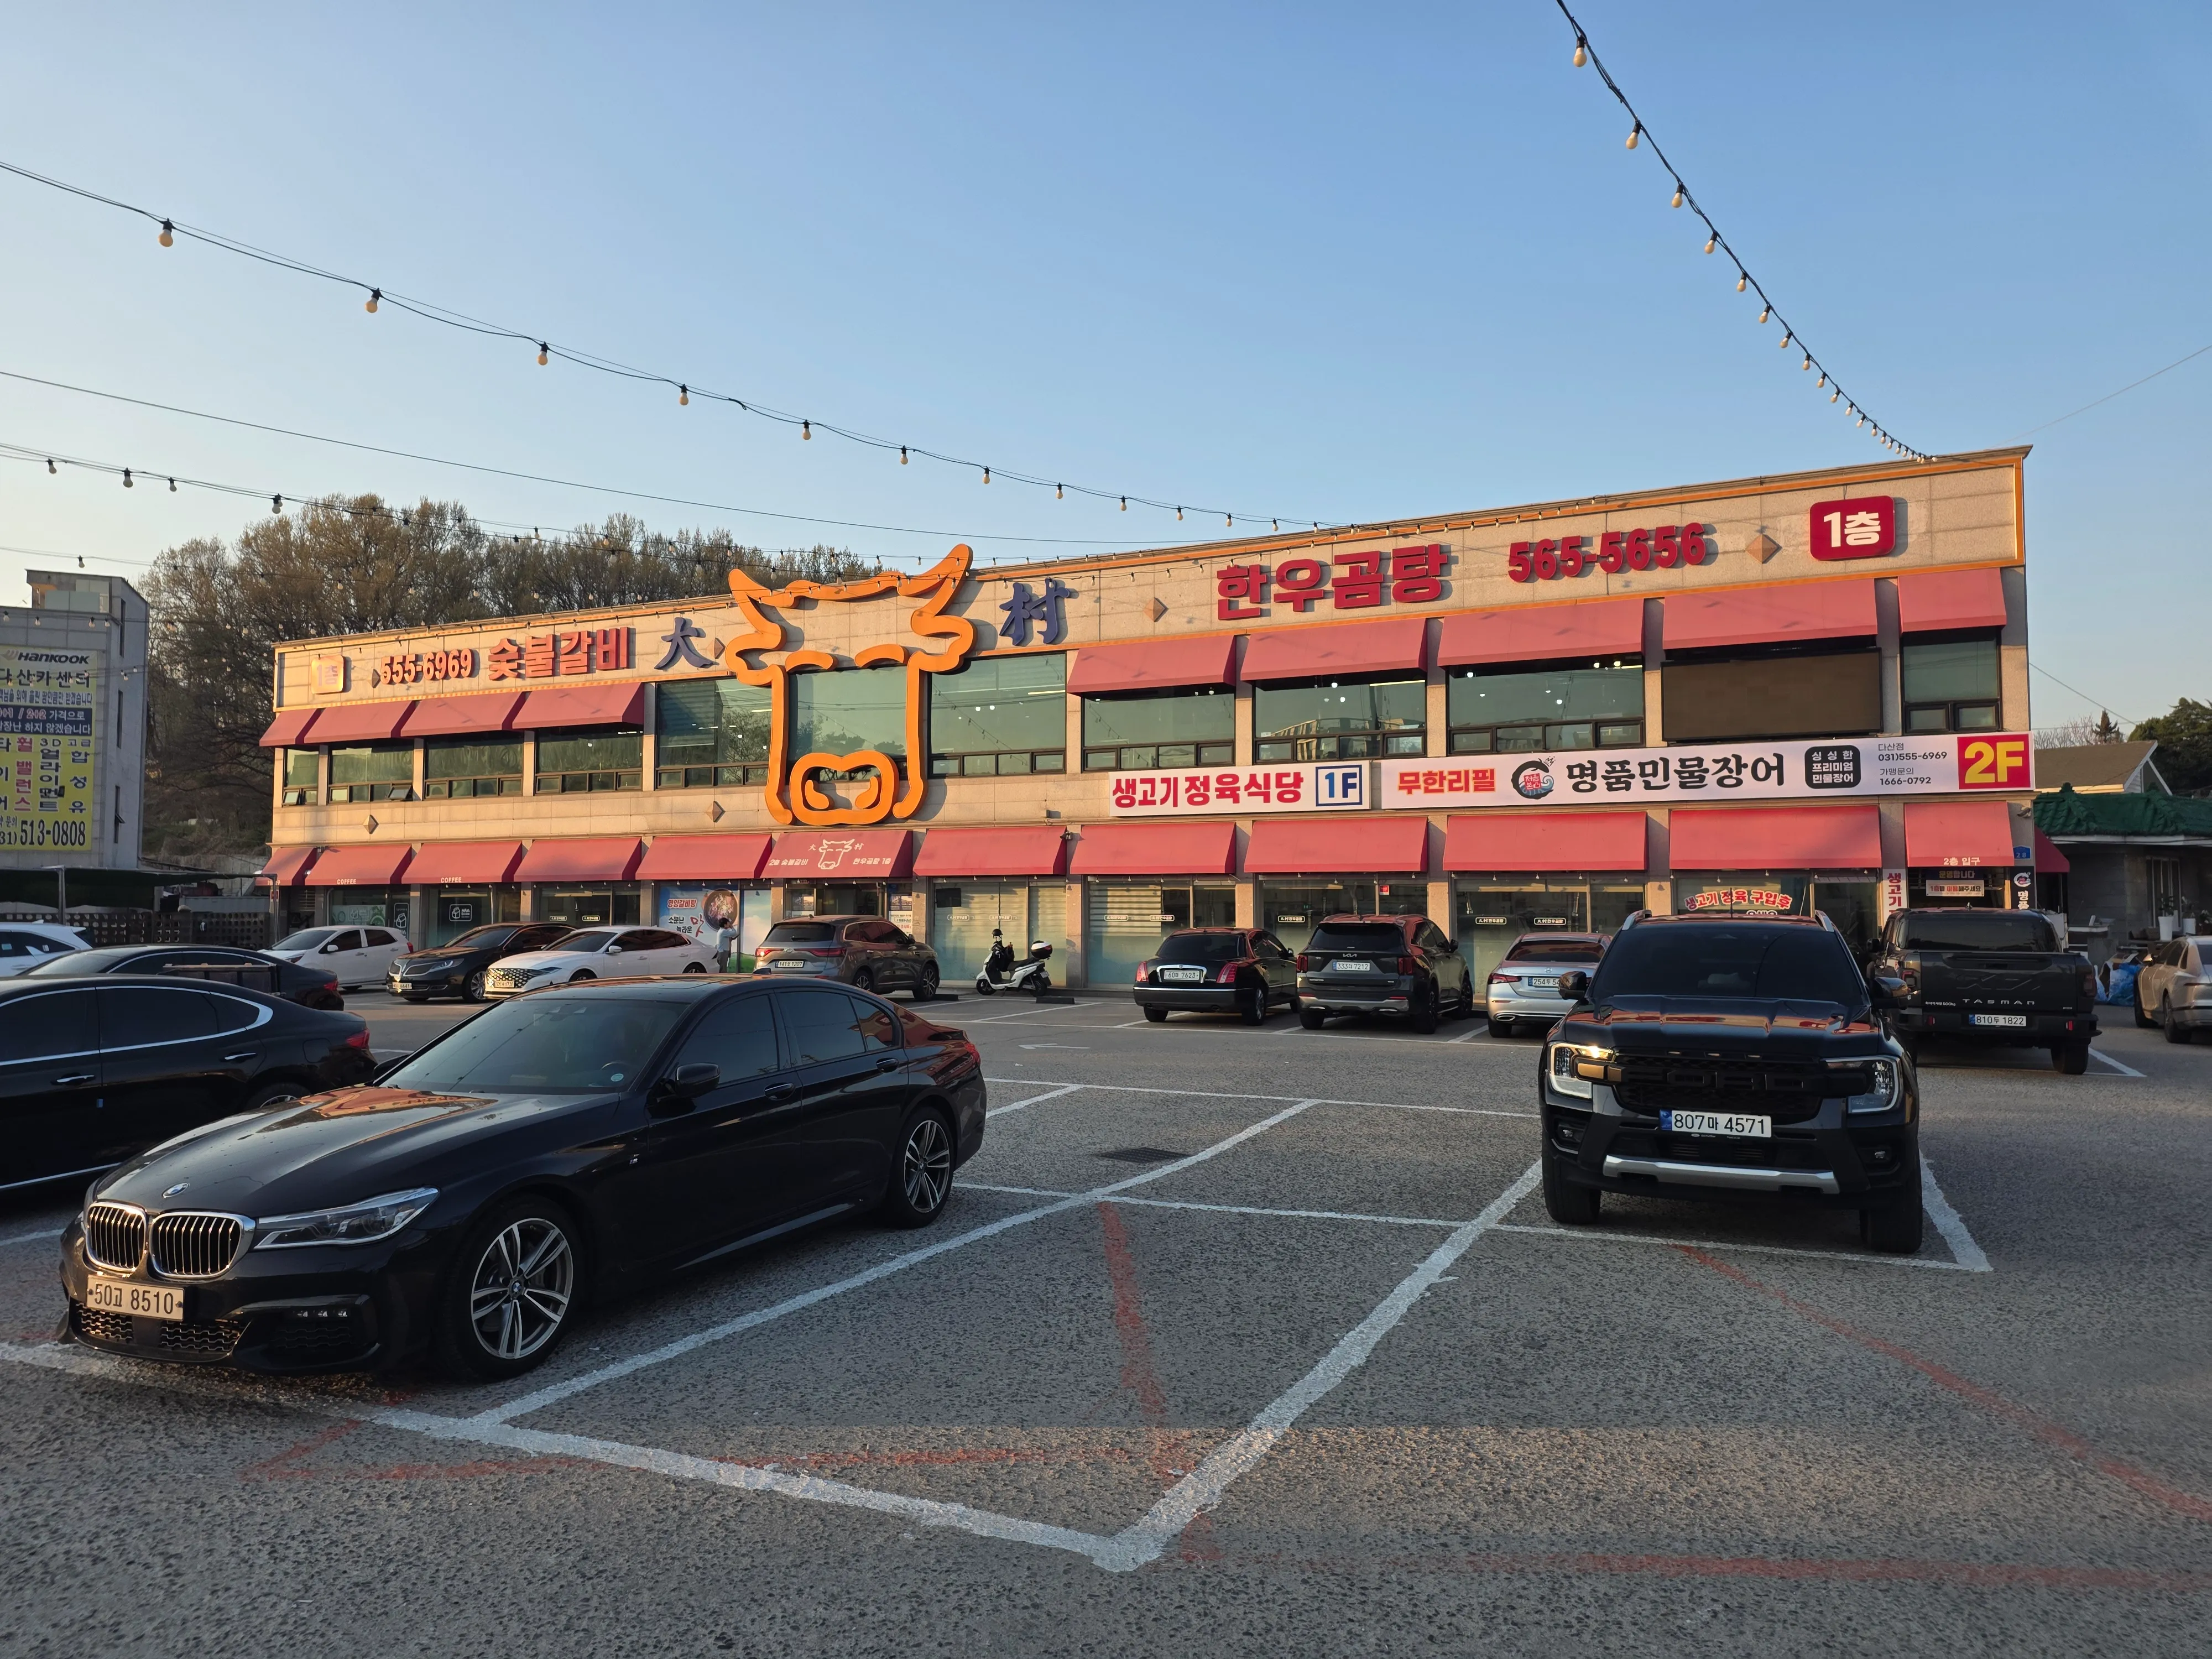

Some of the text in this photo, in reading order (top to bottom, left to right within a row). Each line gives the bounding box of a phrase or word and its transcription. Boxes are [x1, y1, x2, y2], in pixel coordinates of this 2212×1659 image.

[1823, 512, 1881, 547] 1층
[1508, 522, 1706, 583] 565-5656
[1217, 543, 1448, 620] 한우곰탕
[999, 577, 1071, 646] 村
[488, 627, 629, 681] 숯불갈비
[654, 617, 713, 670] 大
[18, 651, 90, 664] Hankook
[380, 648, 474, 685] 555-6969
[65, 692, 92, 706] 받겠습니다
[49, 710, 85, 721] 가격으로
[25, 721, 43, 733] 하지
[46, 723, 91, 734] 않겠습니다
[40, 738, 61, 747] 3D
[1878, 743, 1904, 751] 다산점
[1878, 752, 1947, 761] 031)555-6969
[1964, 742, 2025, 783] 2F
[1566, 753, 1785, 793] 명품민물장어
[1812, 763, 1853, 772] 프리미엄
[1812, 773, 1853, 783] 민물장어
[1325, 772, 1357, 798] 1F
[1397, 768, 1496, 795] 무한리필
[1880, 777, 1932, 785] 1666-0792
[20, 819, 86, 846] 513-0808
[1943, 857, 1980, 866] 2층 입구
[668, 899, 697, 907] 영양갈비탕
[1685, 892, 1718, 910] 생고기
[1750, 890, 1792, 909] 구입후
[690, 914, 704, 938] 맛
[1976, 1015, 2024, 1025] 810두 1822
[1674, 1113, 1764, 1134] 807마 4571
[131, 1287, 174, 1314] 8510
